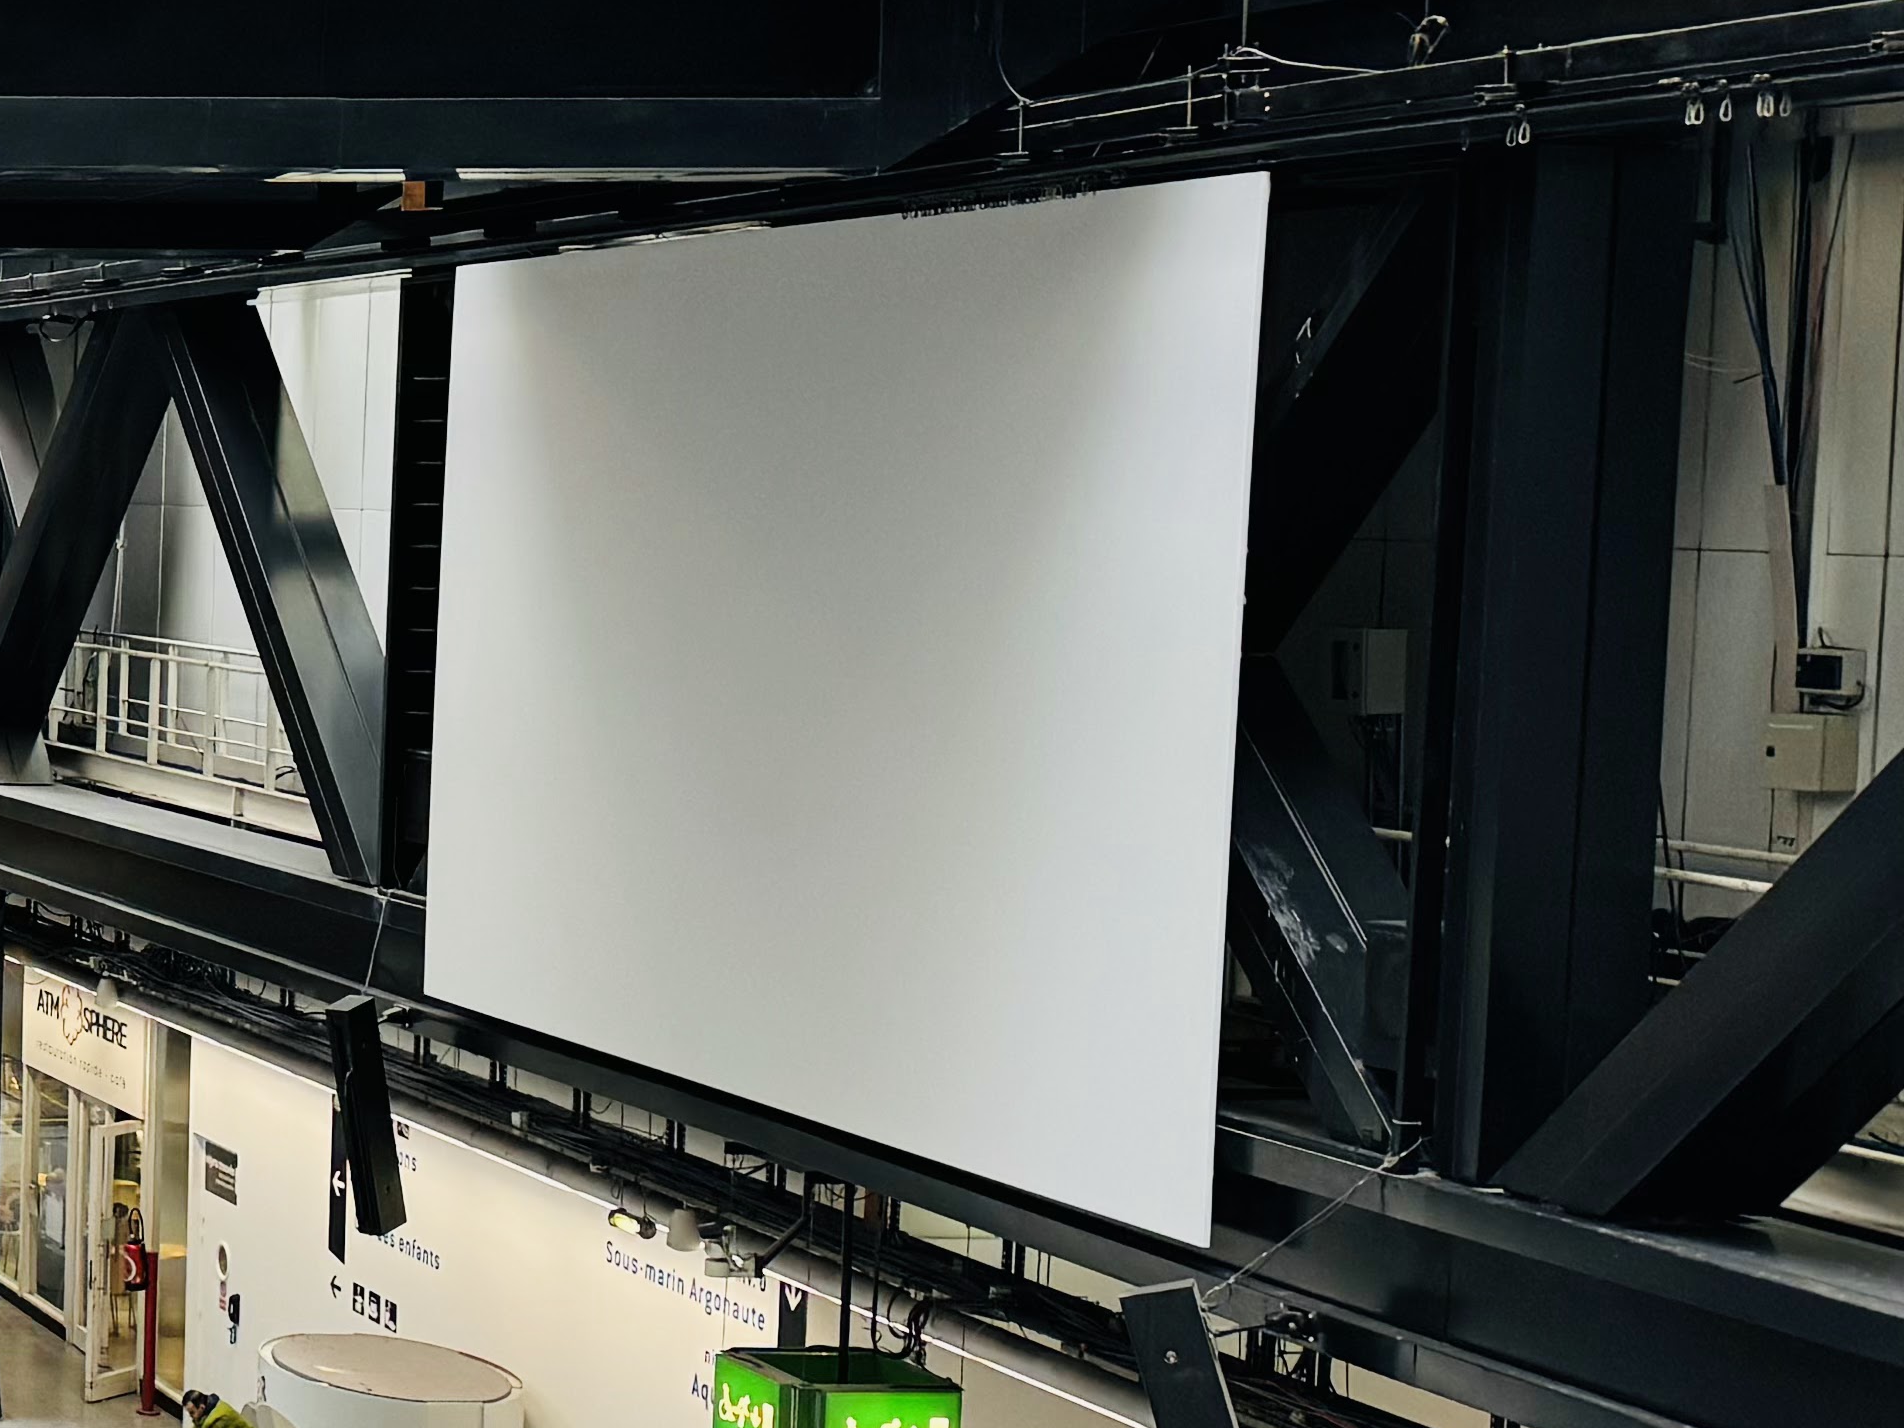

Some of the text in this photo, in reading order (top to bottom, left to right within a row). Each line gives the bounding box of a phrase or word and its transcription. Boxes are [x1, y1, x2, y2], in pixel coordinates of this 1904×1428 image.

[399, 1235, 441, 1270] enfants
[605, 1239, 766, 1332] Sous-marin Argonaute
